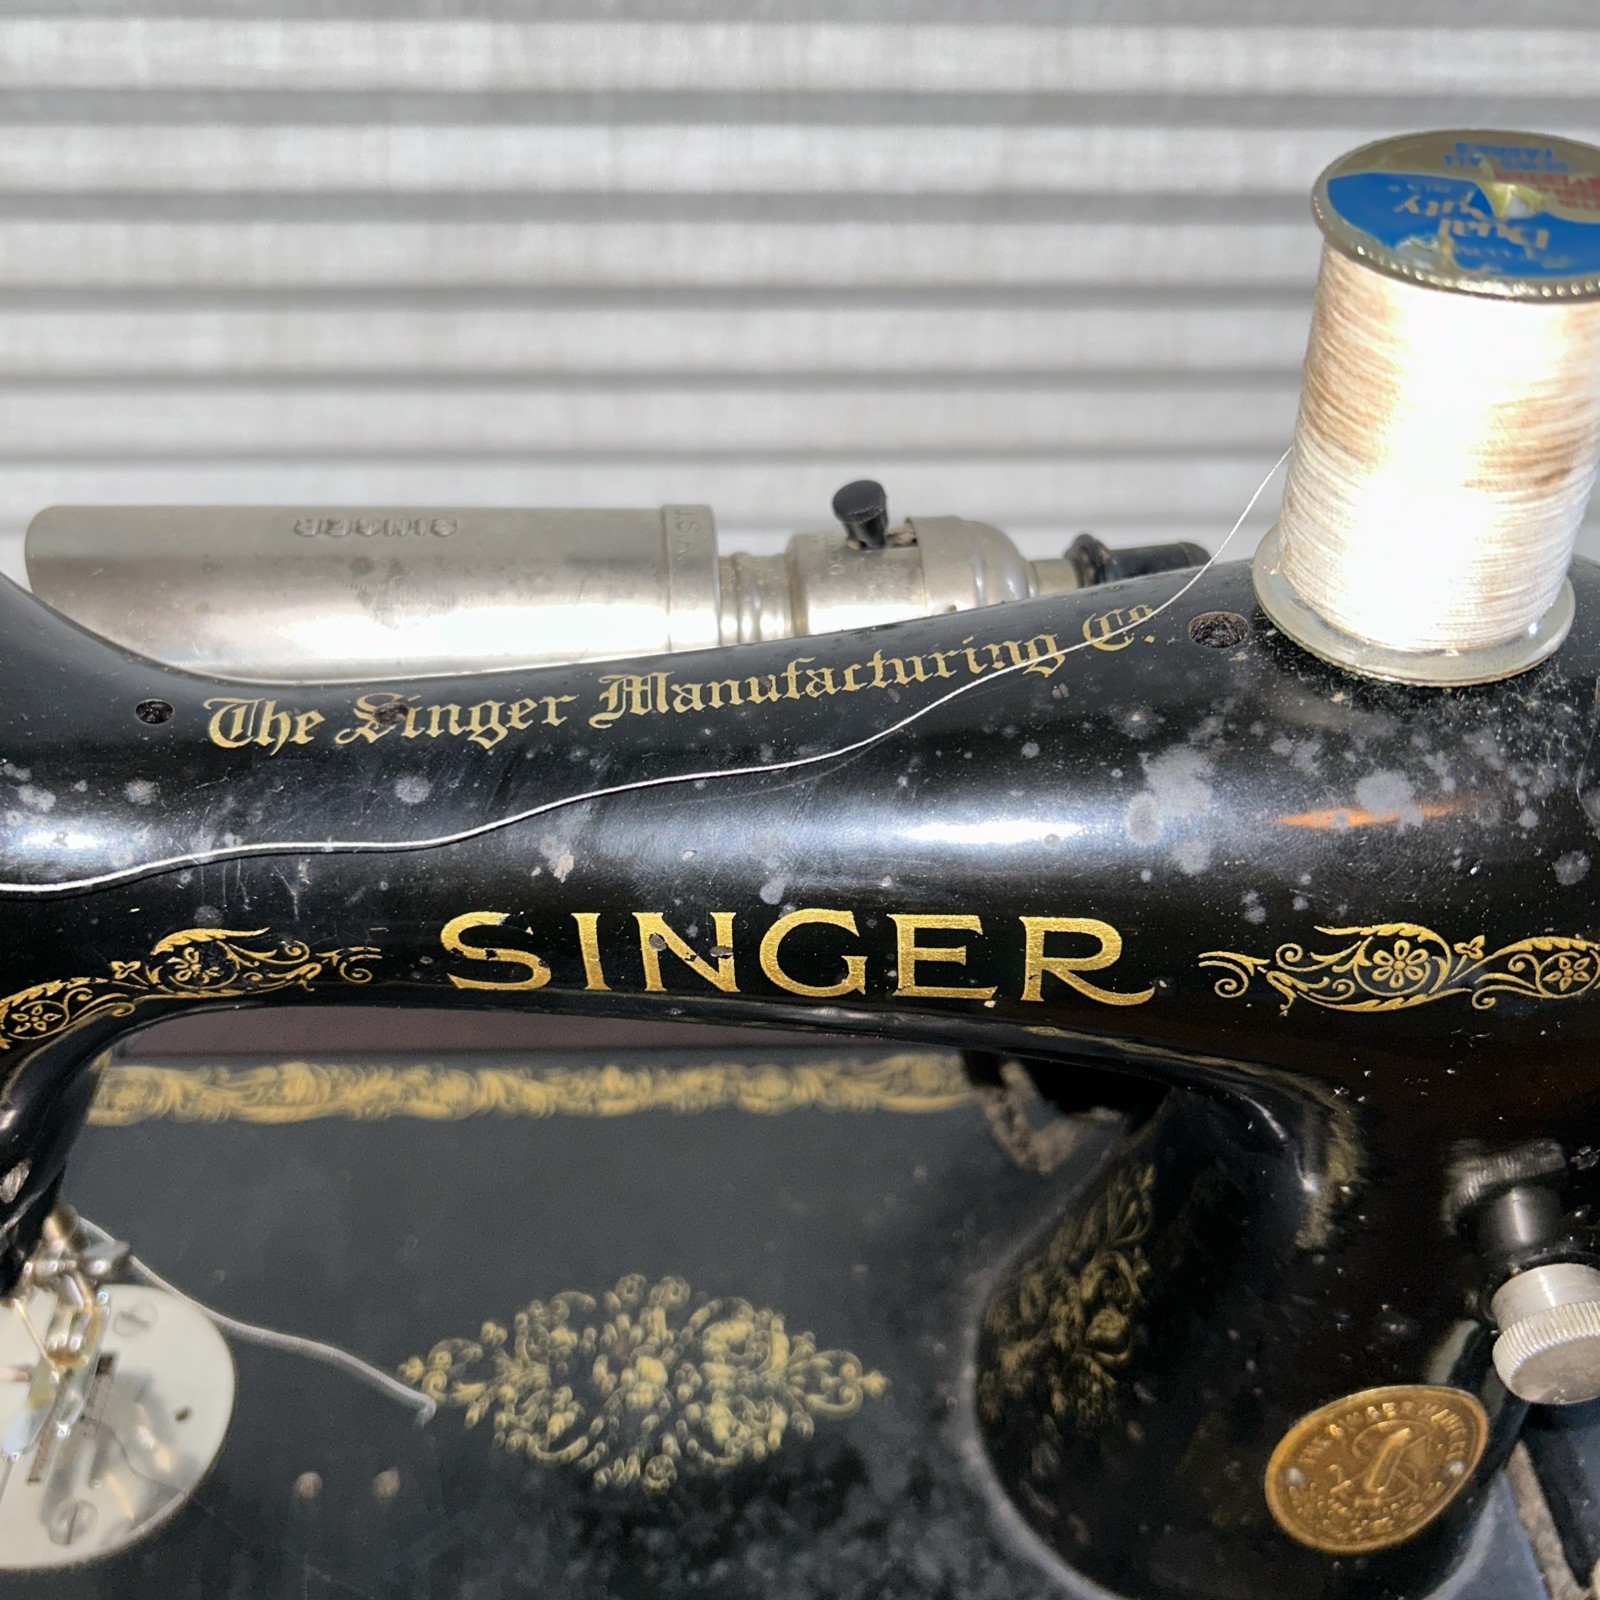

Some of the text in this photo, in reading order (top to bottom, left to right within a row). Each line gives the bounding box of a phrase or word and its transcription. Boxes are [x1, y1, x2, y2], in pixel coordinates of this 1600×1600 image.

[293, 516, 458, 537] SINGER
[204, 697, 325, 756] The
[335, 692, 580, 750] Singer
[588, 632, 1066, 729] Manufacturing
[440, 908, 1156, 1006] SINGER
